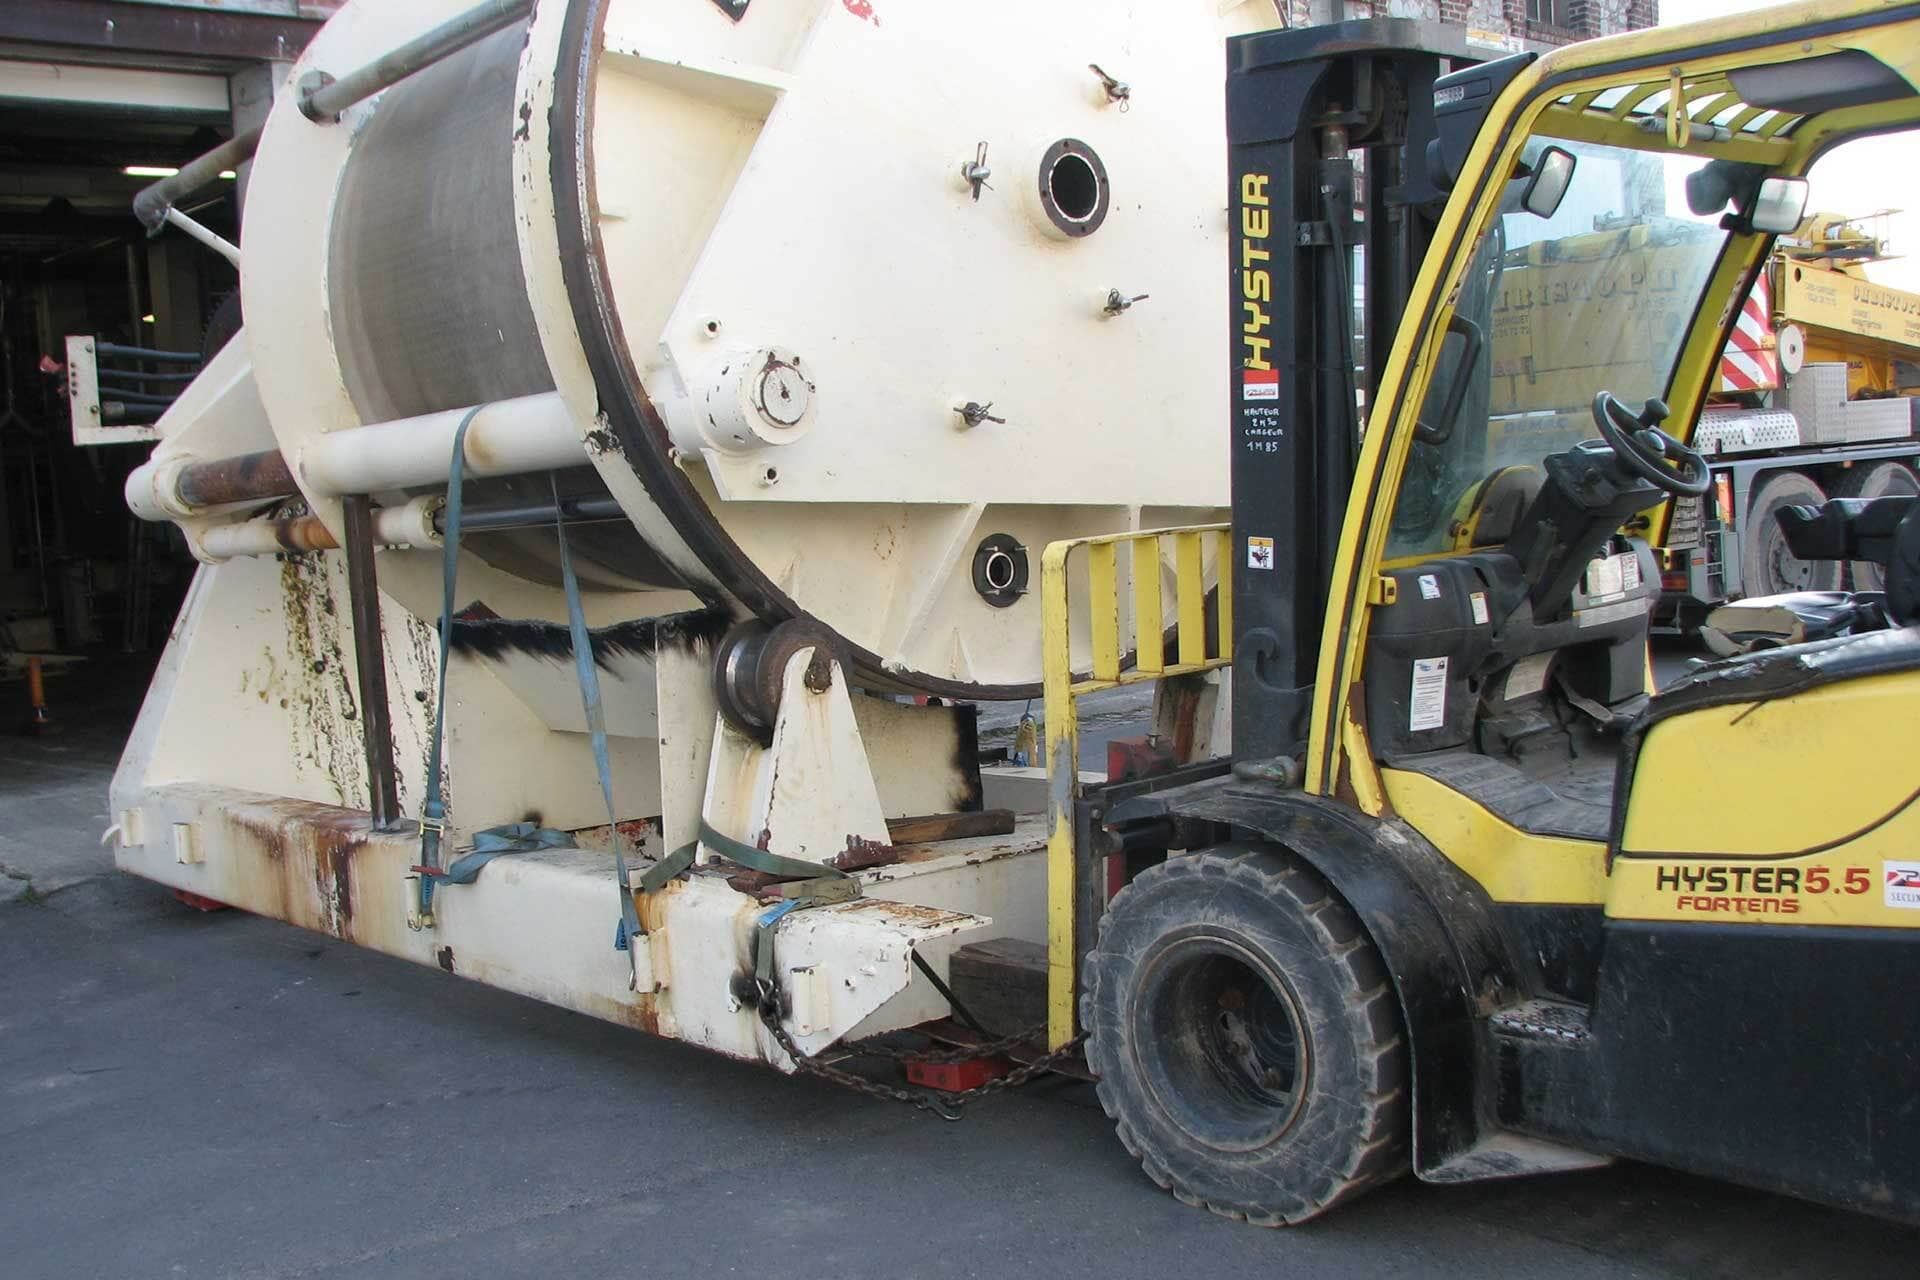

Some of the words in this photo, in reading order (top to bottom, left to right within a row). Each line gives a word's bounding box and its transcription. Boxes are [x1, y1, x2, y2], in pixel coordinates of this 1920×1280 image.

[1242, 173, 1271, 371] HYSTER
[1243, 407, 1280, 417] HAUTEUR
[1656, 865, 1800, 894] HYSTER
[1804, 866, 1871, 895] 5.5
[1677, 895, 1799, 914] FORTENS
